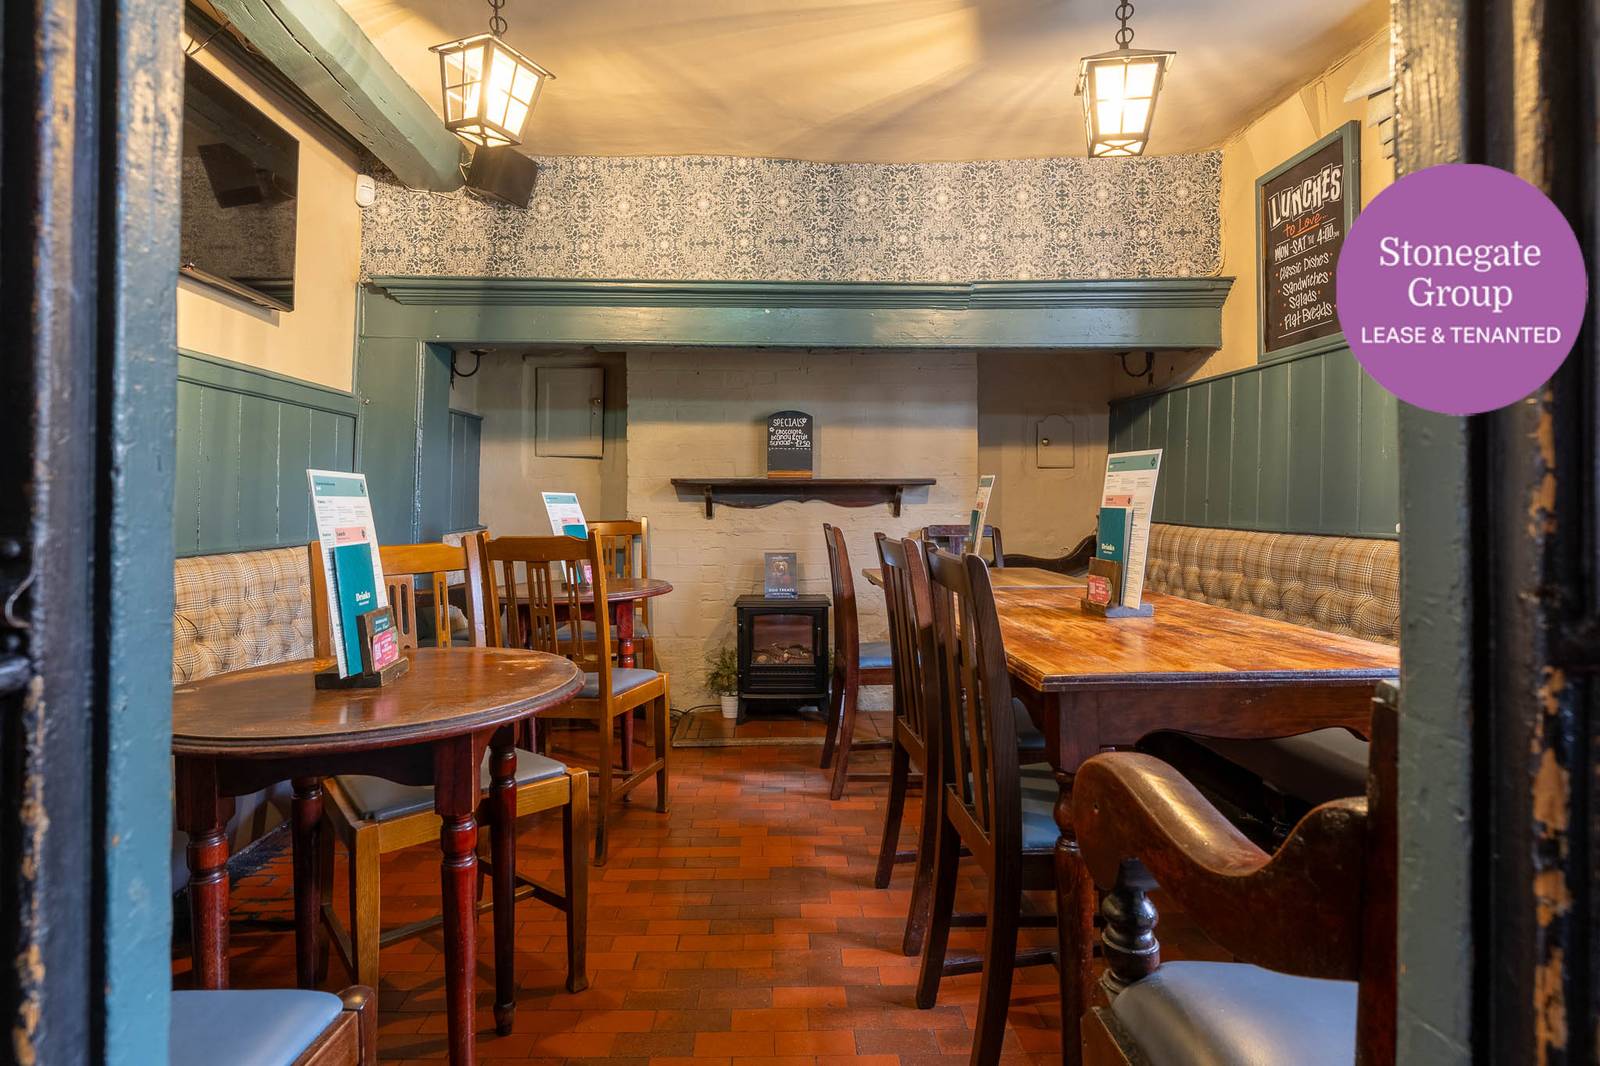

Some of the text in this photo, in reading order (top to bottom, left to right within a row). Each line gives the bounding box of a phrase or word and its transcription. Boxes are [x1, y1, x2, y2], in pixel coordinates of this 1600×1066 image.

[1270, 167, 1342, 228] LUNCHES
[1283, 223, 1296, 237] to
[1303, 252, 1329, 272] Dishes
[1282, 271, 1329, 297] Sandwiches
[1288, 290, 1317, 309] Salads
[772, 417, 805, 428] SPECIALS
